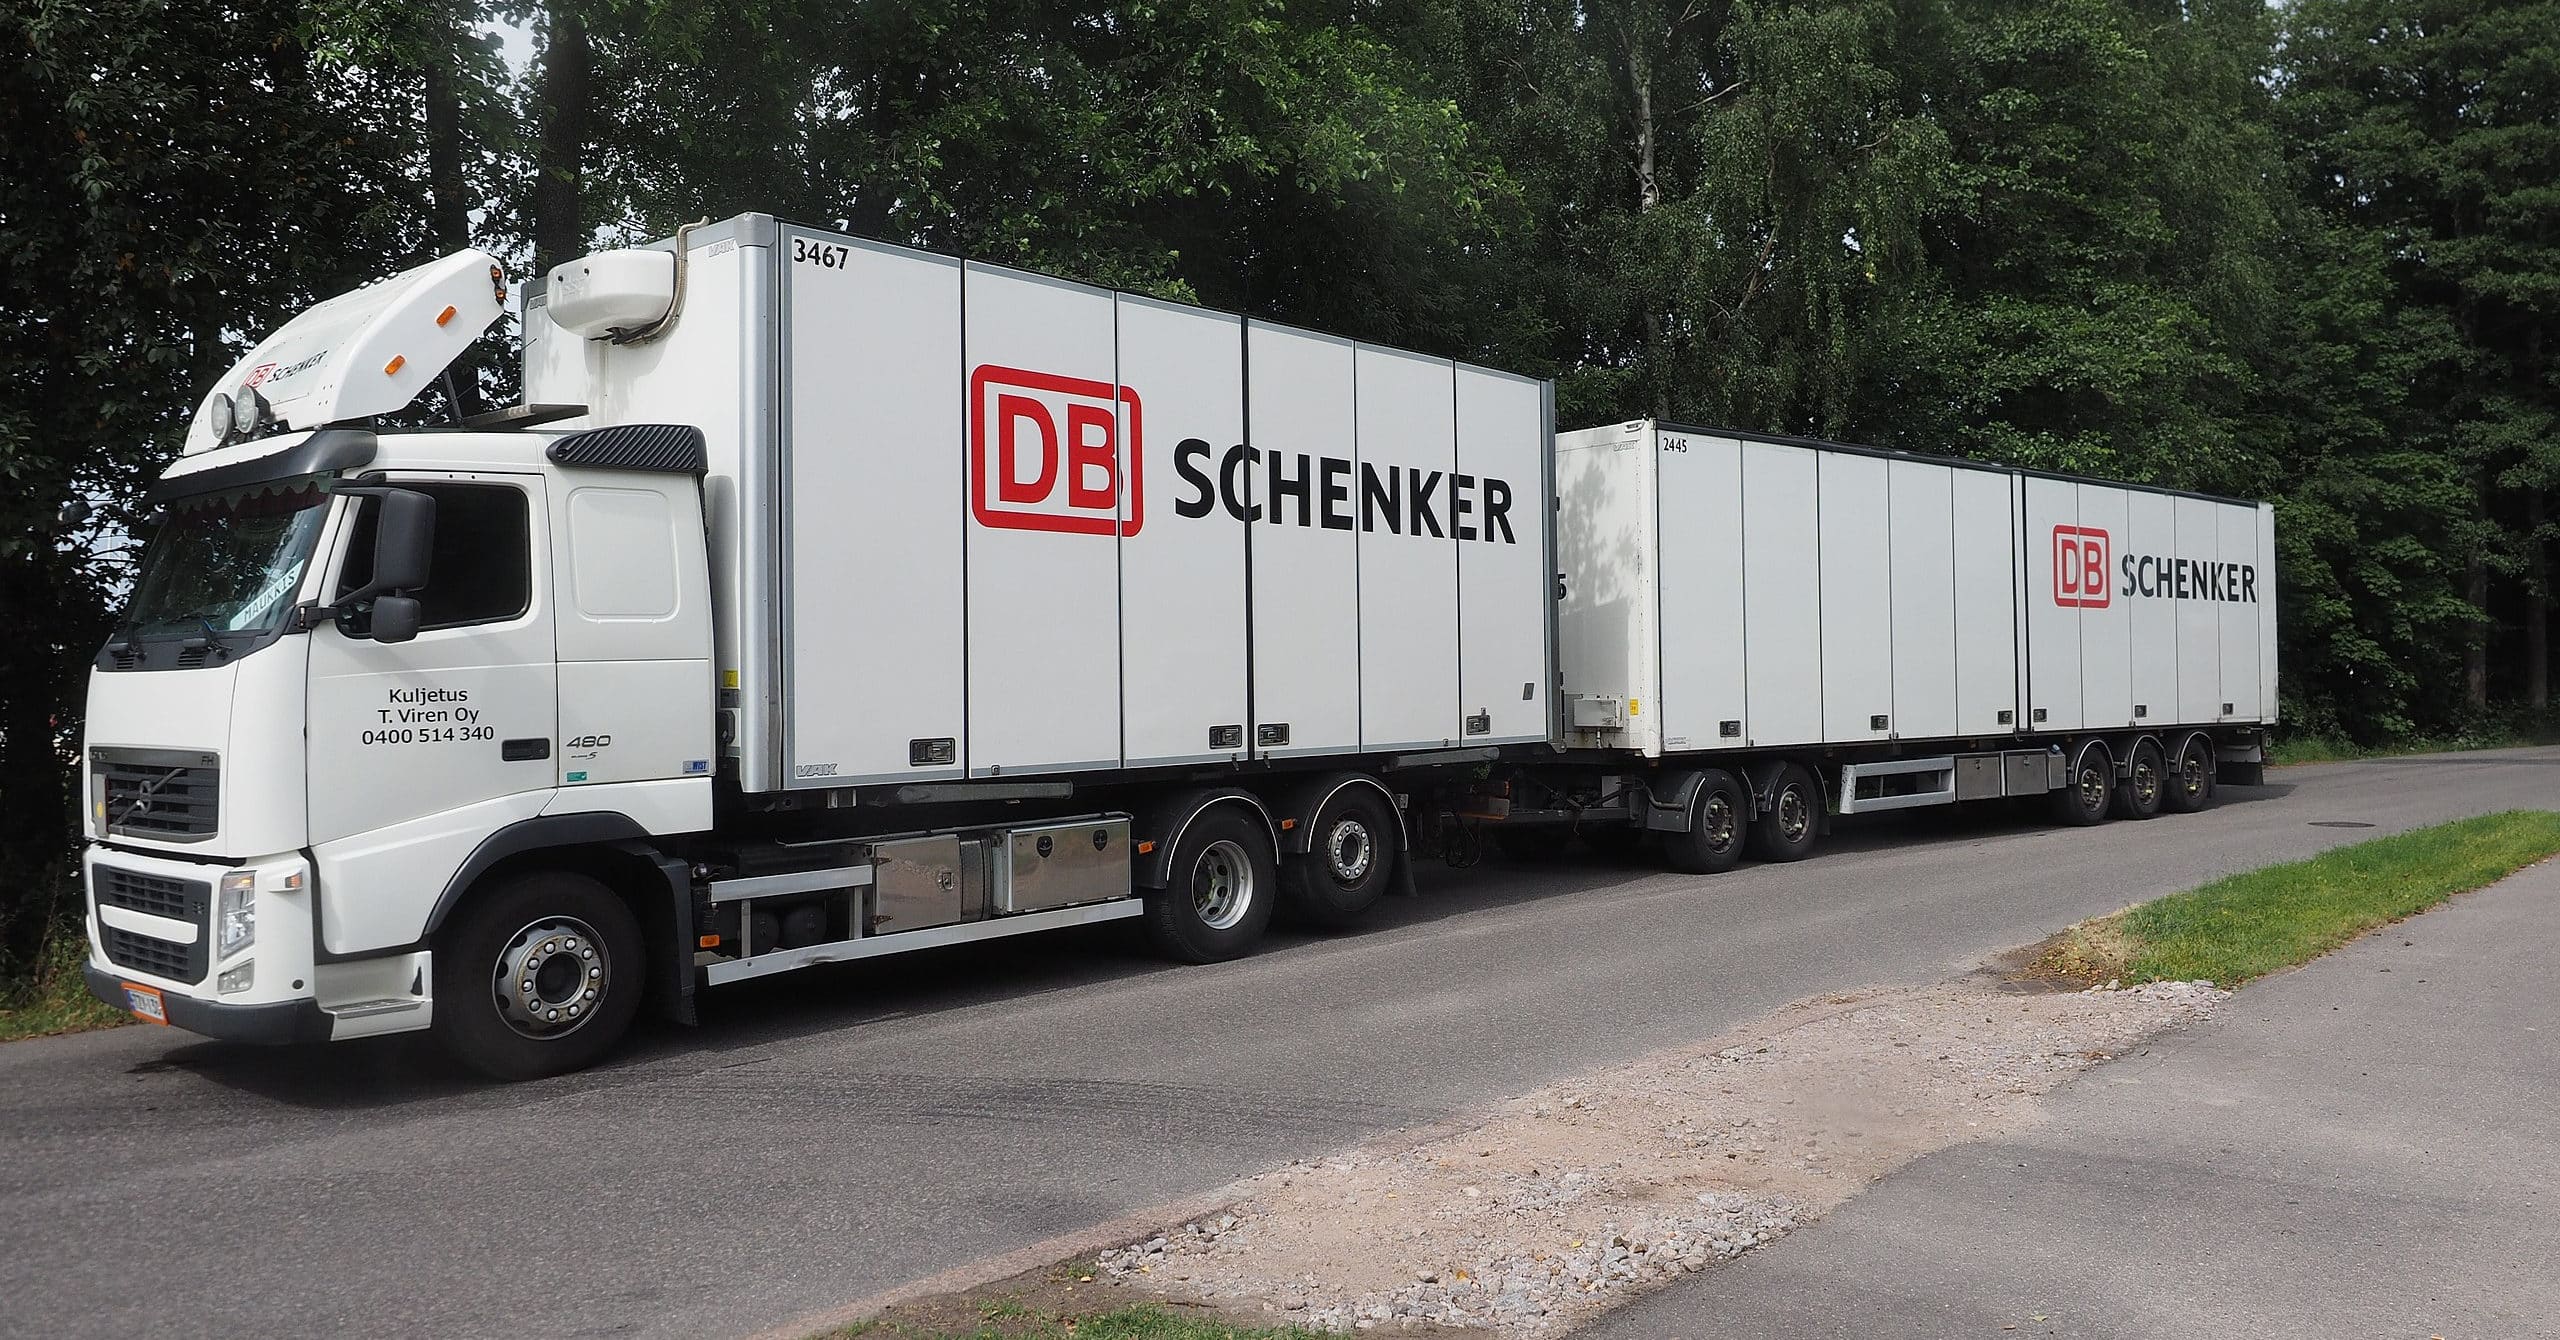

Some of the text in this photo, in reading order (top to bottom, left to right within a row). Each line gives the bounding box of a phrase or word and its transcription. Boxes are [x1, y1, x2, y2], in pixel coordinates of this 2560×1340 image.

[793, 239, 849, 270] 3467
[1663, 437, 1688, 453] 2445
[998, 393, 1517, 545] DB SCHENKER
[2121, 554, 2258, 603] SCHENKER
[389, 687, 468, 706] Kuljetus
[377, 707, 480, 725] T. Viren Oy
[362, 725, 494, 745] 0400 514 340
[566, 735, 611, 748] 480
[796, 763, 838, 777] VAK
